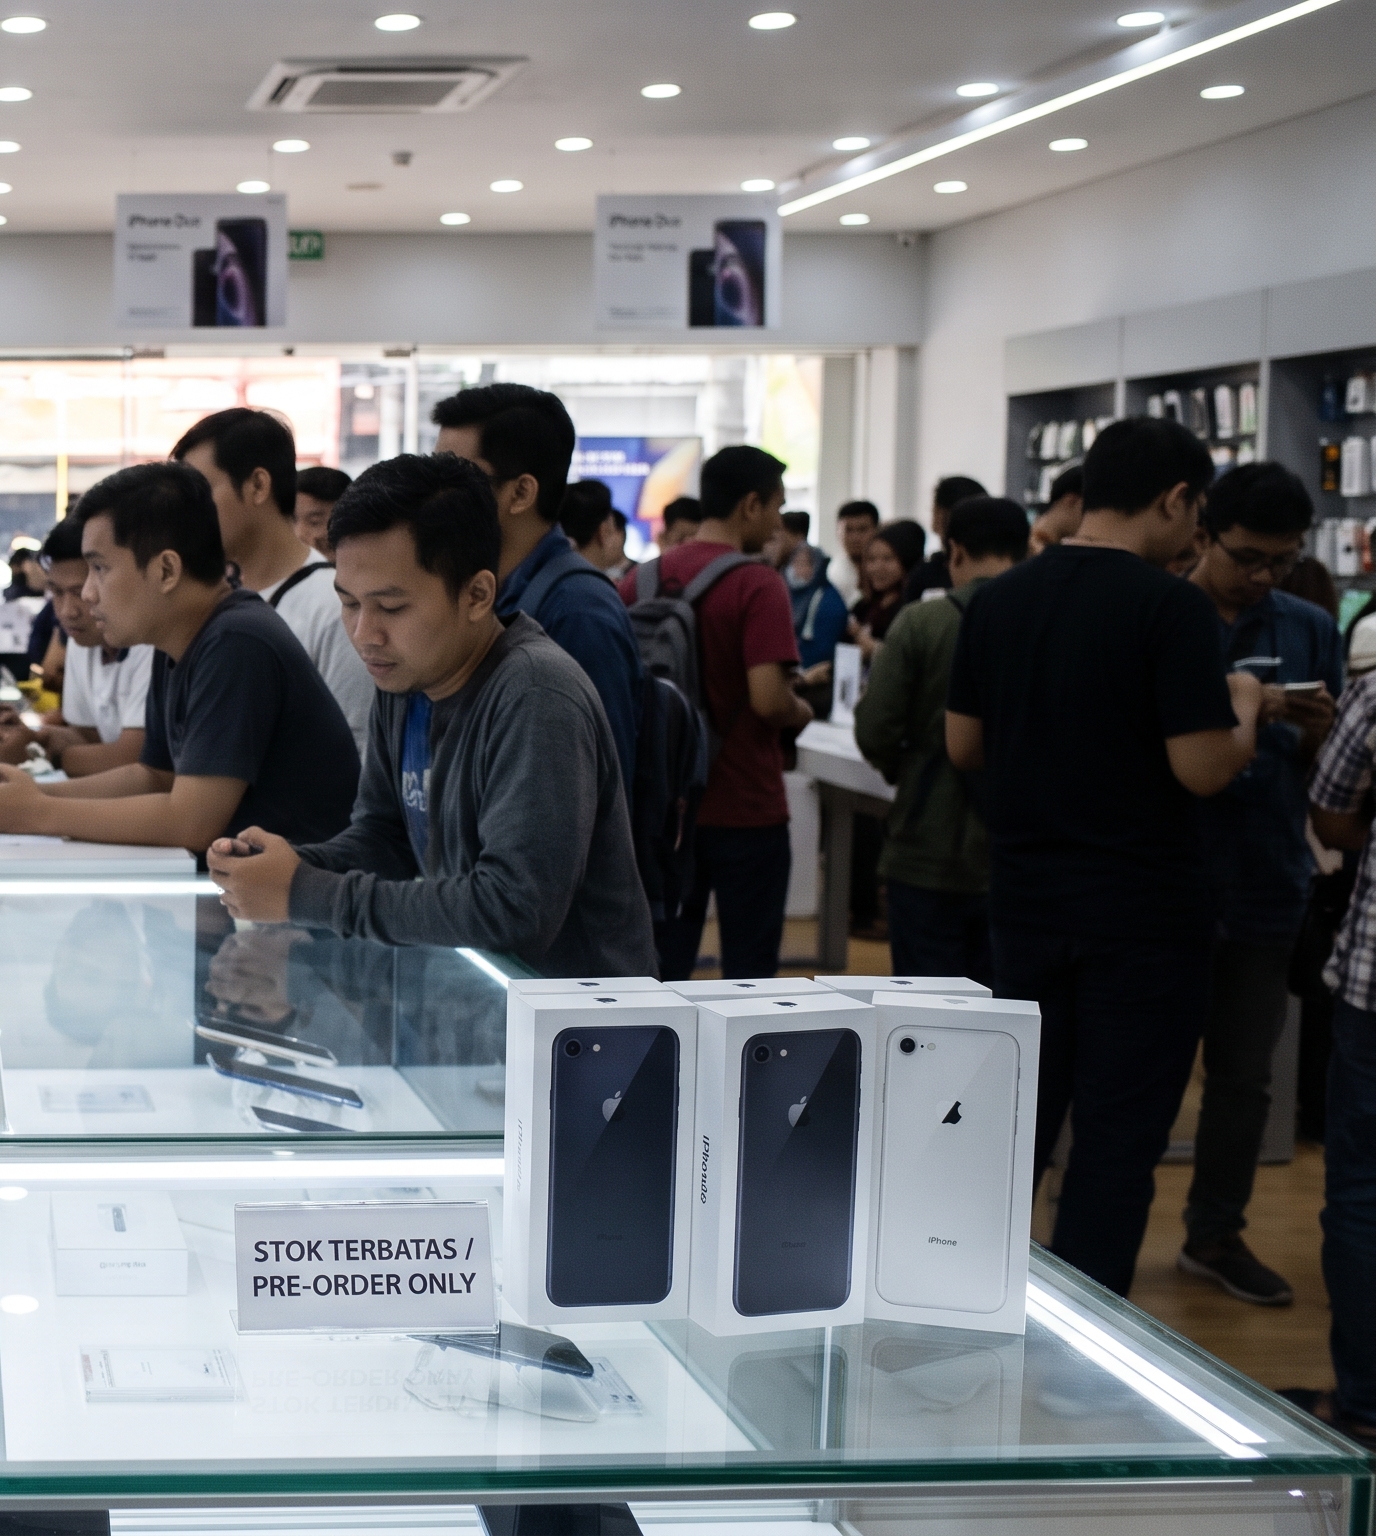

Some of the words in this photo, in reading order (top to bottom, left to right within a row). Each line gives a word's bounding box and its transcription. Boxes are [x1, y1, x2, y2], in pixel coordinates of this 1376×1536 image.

[254, 1239, 324, 1263] STOK
[327, 1237, 458, 1262] TERBATAS
[464, 1237, 474, 1261] /
[927, 1236, 959, 1247] iPhone
[252, 1273, 402, 1298] PRE-ORDER
[408, 1272, 476, 1295] ONLY
